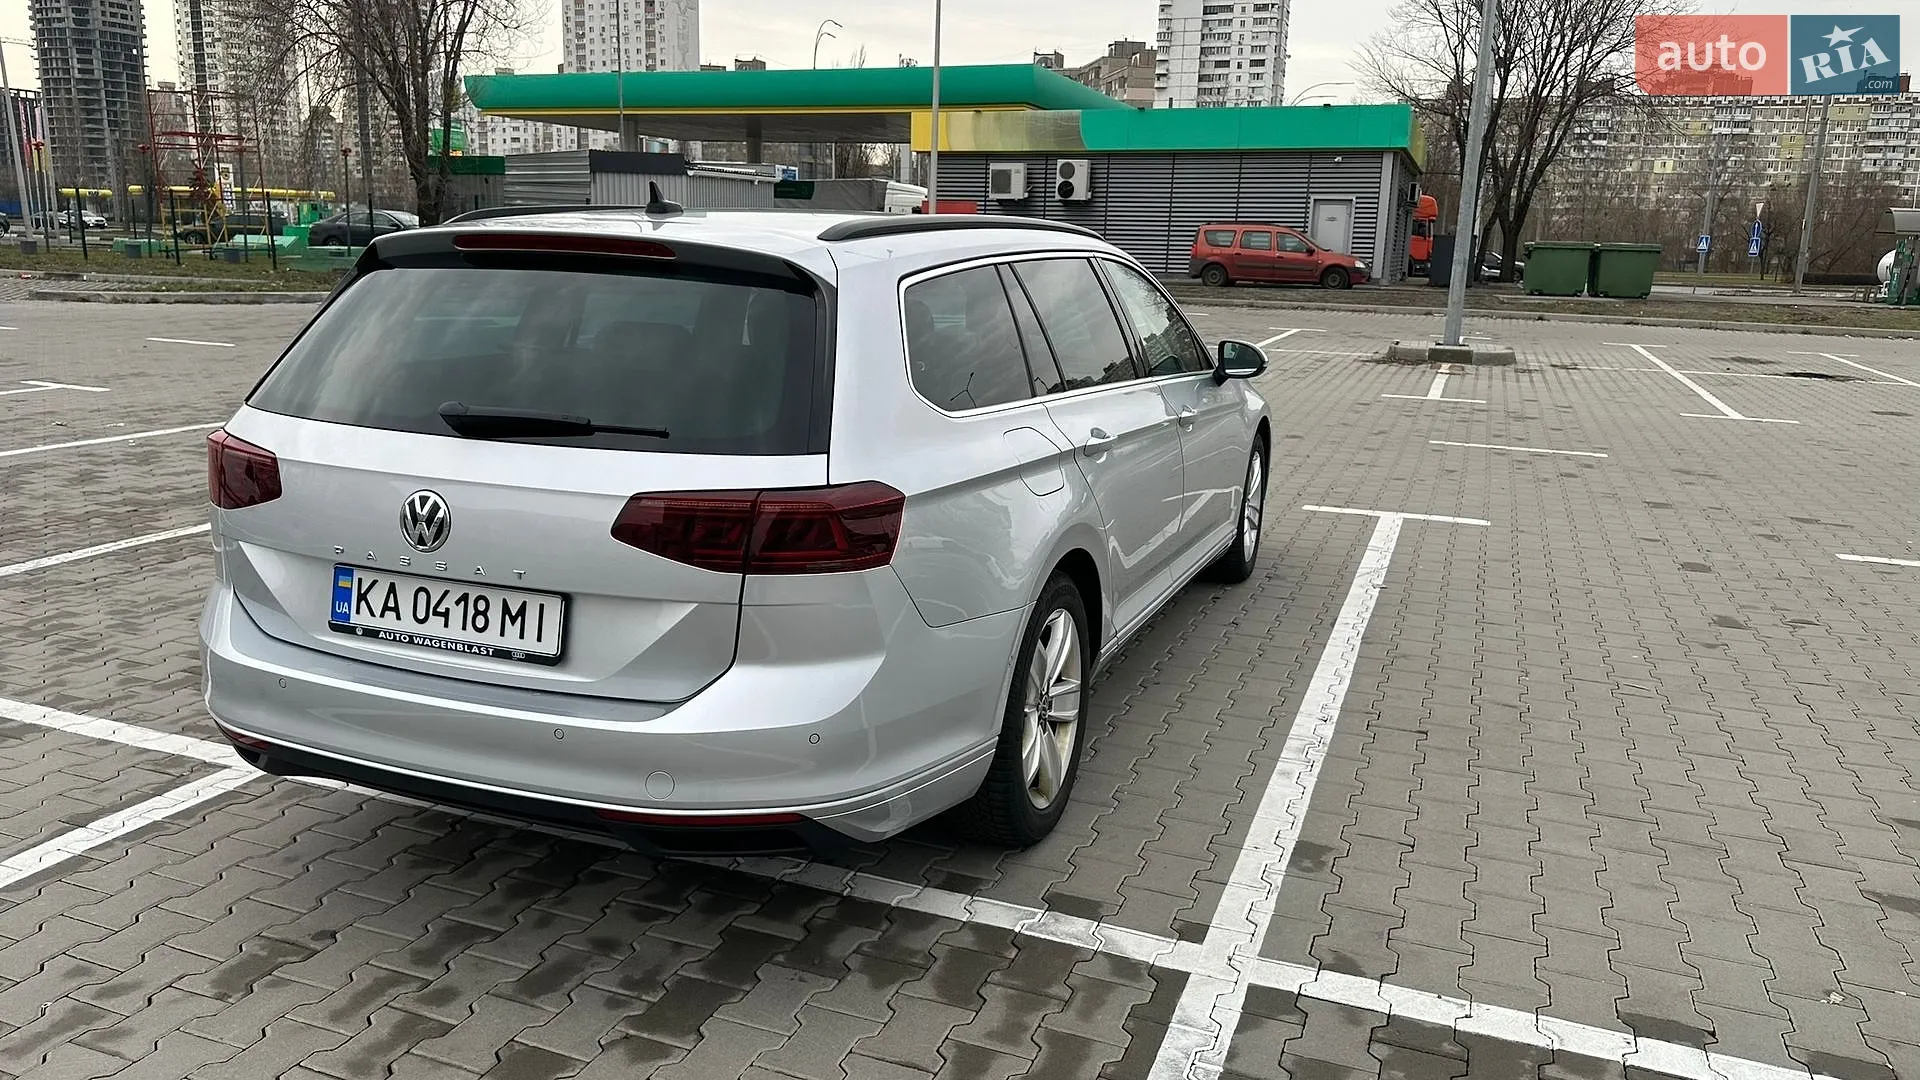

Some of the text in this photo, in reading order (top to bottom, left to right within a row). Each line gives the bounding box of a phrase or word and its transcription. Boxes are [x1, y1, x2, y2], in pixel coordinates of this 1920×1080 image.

[333, 544, 527, 580] PASSAT
[335, 600, 349, 615] UA
[355, 577, 545, 643] KA 0418 MI
[378, 630, 495, 657] AUTO WAGENBLAST
